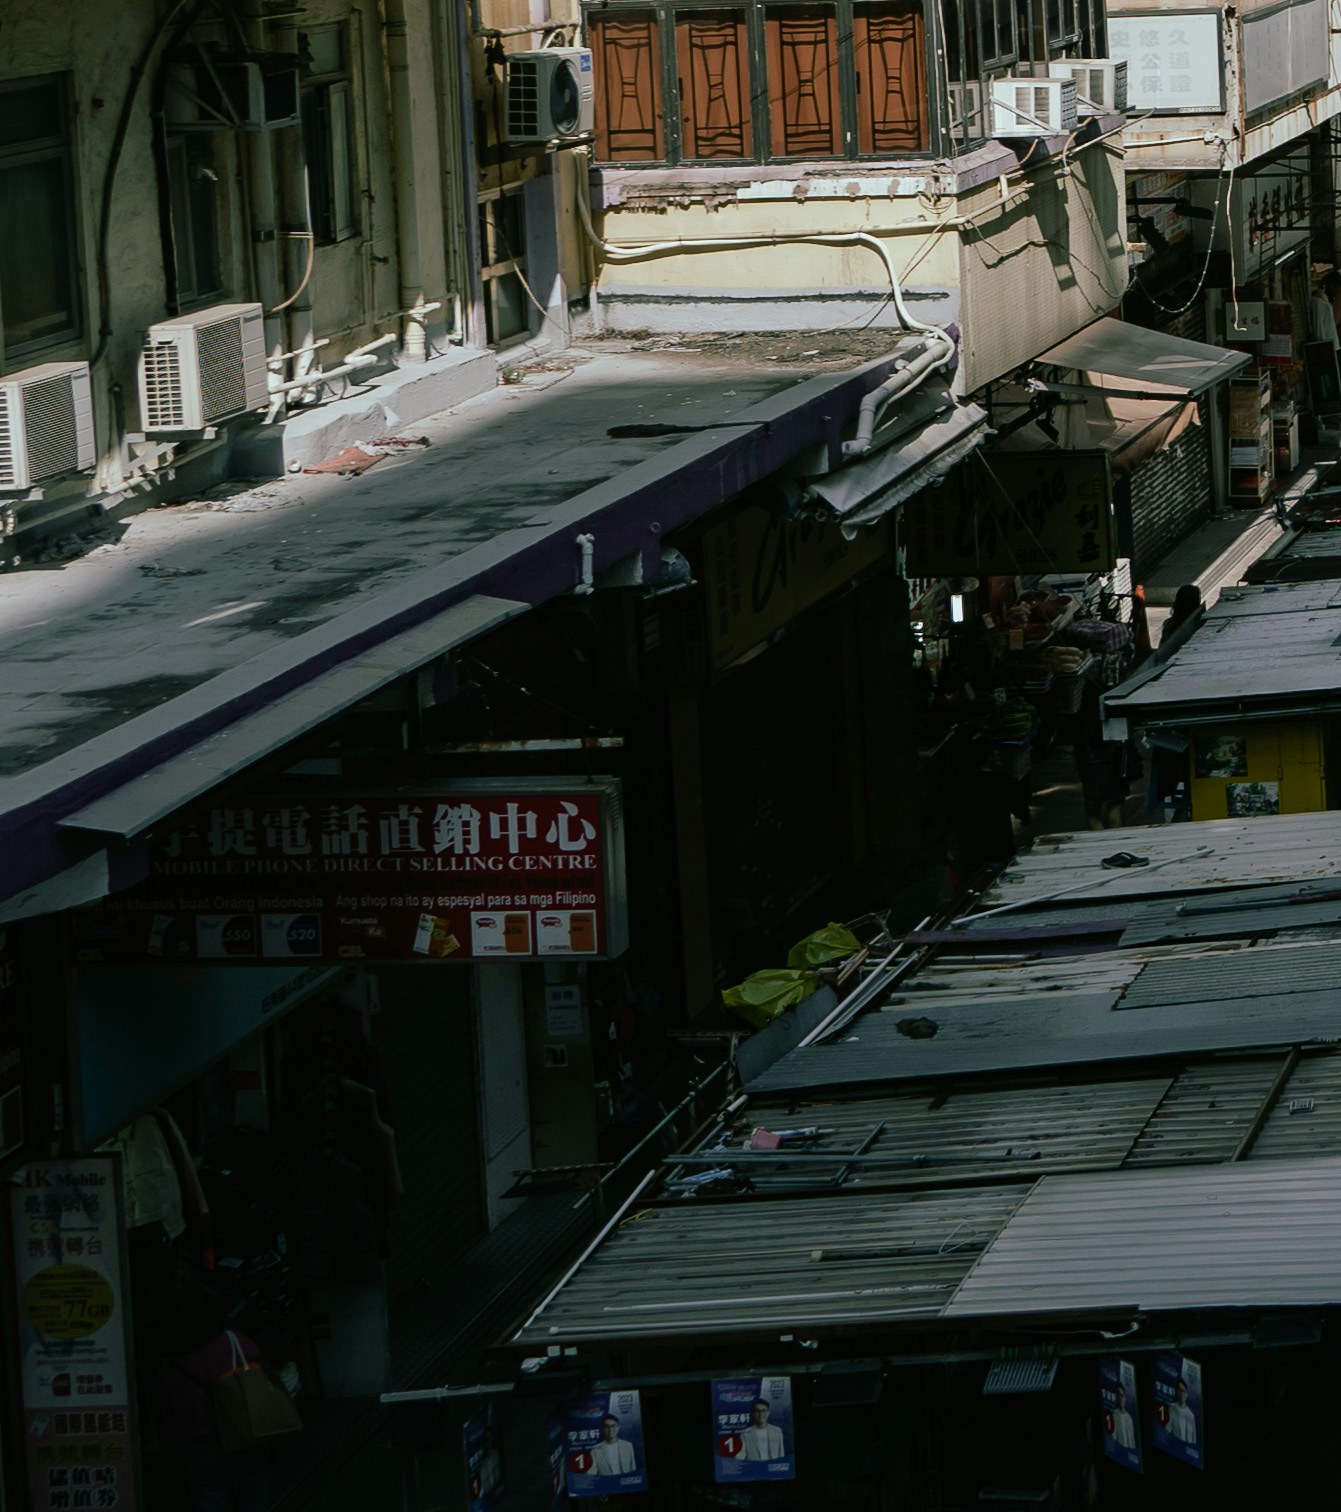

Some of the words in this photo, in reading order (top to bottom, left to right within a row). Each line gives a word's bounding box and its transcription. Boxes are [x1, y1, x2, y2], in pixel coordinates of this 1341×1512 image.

[151, 860, 241, 877] MOBILE
[243, 859, 320, 875] PHONE
[323, 858, 406, 874] DIRECT
[409, 855, 503, 872] SELLING
[508, 853, 598, 870] CENTRE
[213, 895, 255, 912] Orang
[258, 894, 324, 910] Indonesia
[336, 894, 357, 910] Ang
[360, 894, 387, 910] shop
[421, 896, 434, 910] ay
[437, 893, 485, 910] espesyal
[487, 894, 512, 909] para
[514, 895, 527, 906] sa
[529, 894, 553, 909] mga
[555, 891, 596, 909] Filipino
[56, 1172, 106, 1186] Mobile
[64, 1299, 110, 1319] 77GB
